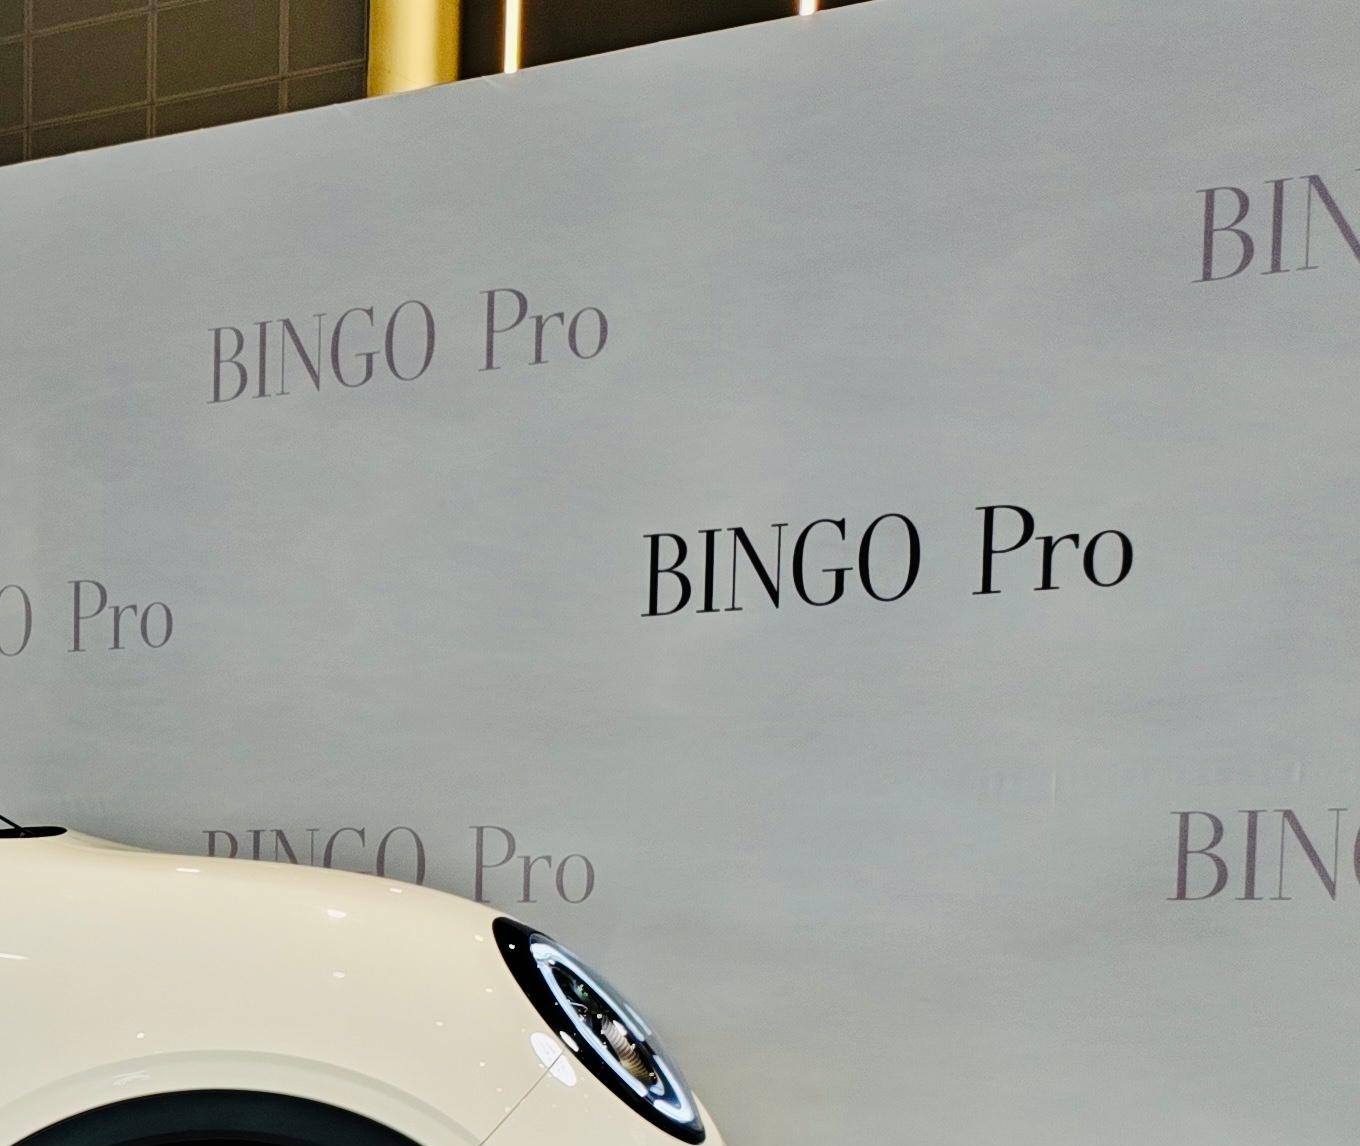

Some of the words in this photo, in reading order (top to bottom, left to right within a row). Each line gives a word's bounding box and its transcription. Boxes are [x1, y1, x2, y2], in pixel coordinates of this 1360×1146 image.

[206, 299, 437, 404] BINGO
[479, 288, 609, 373] Pro
[640, 512, 922, 618] BINGO
[971, 503, 1134, 596] Pro
[66, 579, 175, 653] Pro
[467, 825, 596, 904] Pro
[1166, 808, 1360, 901] BIN
